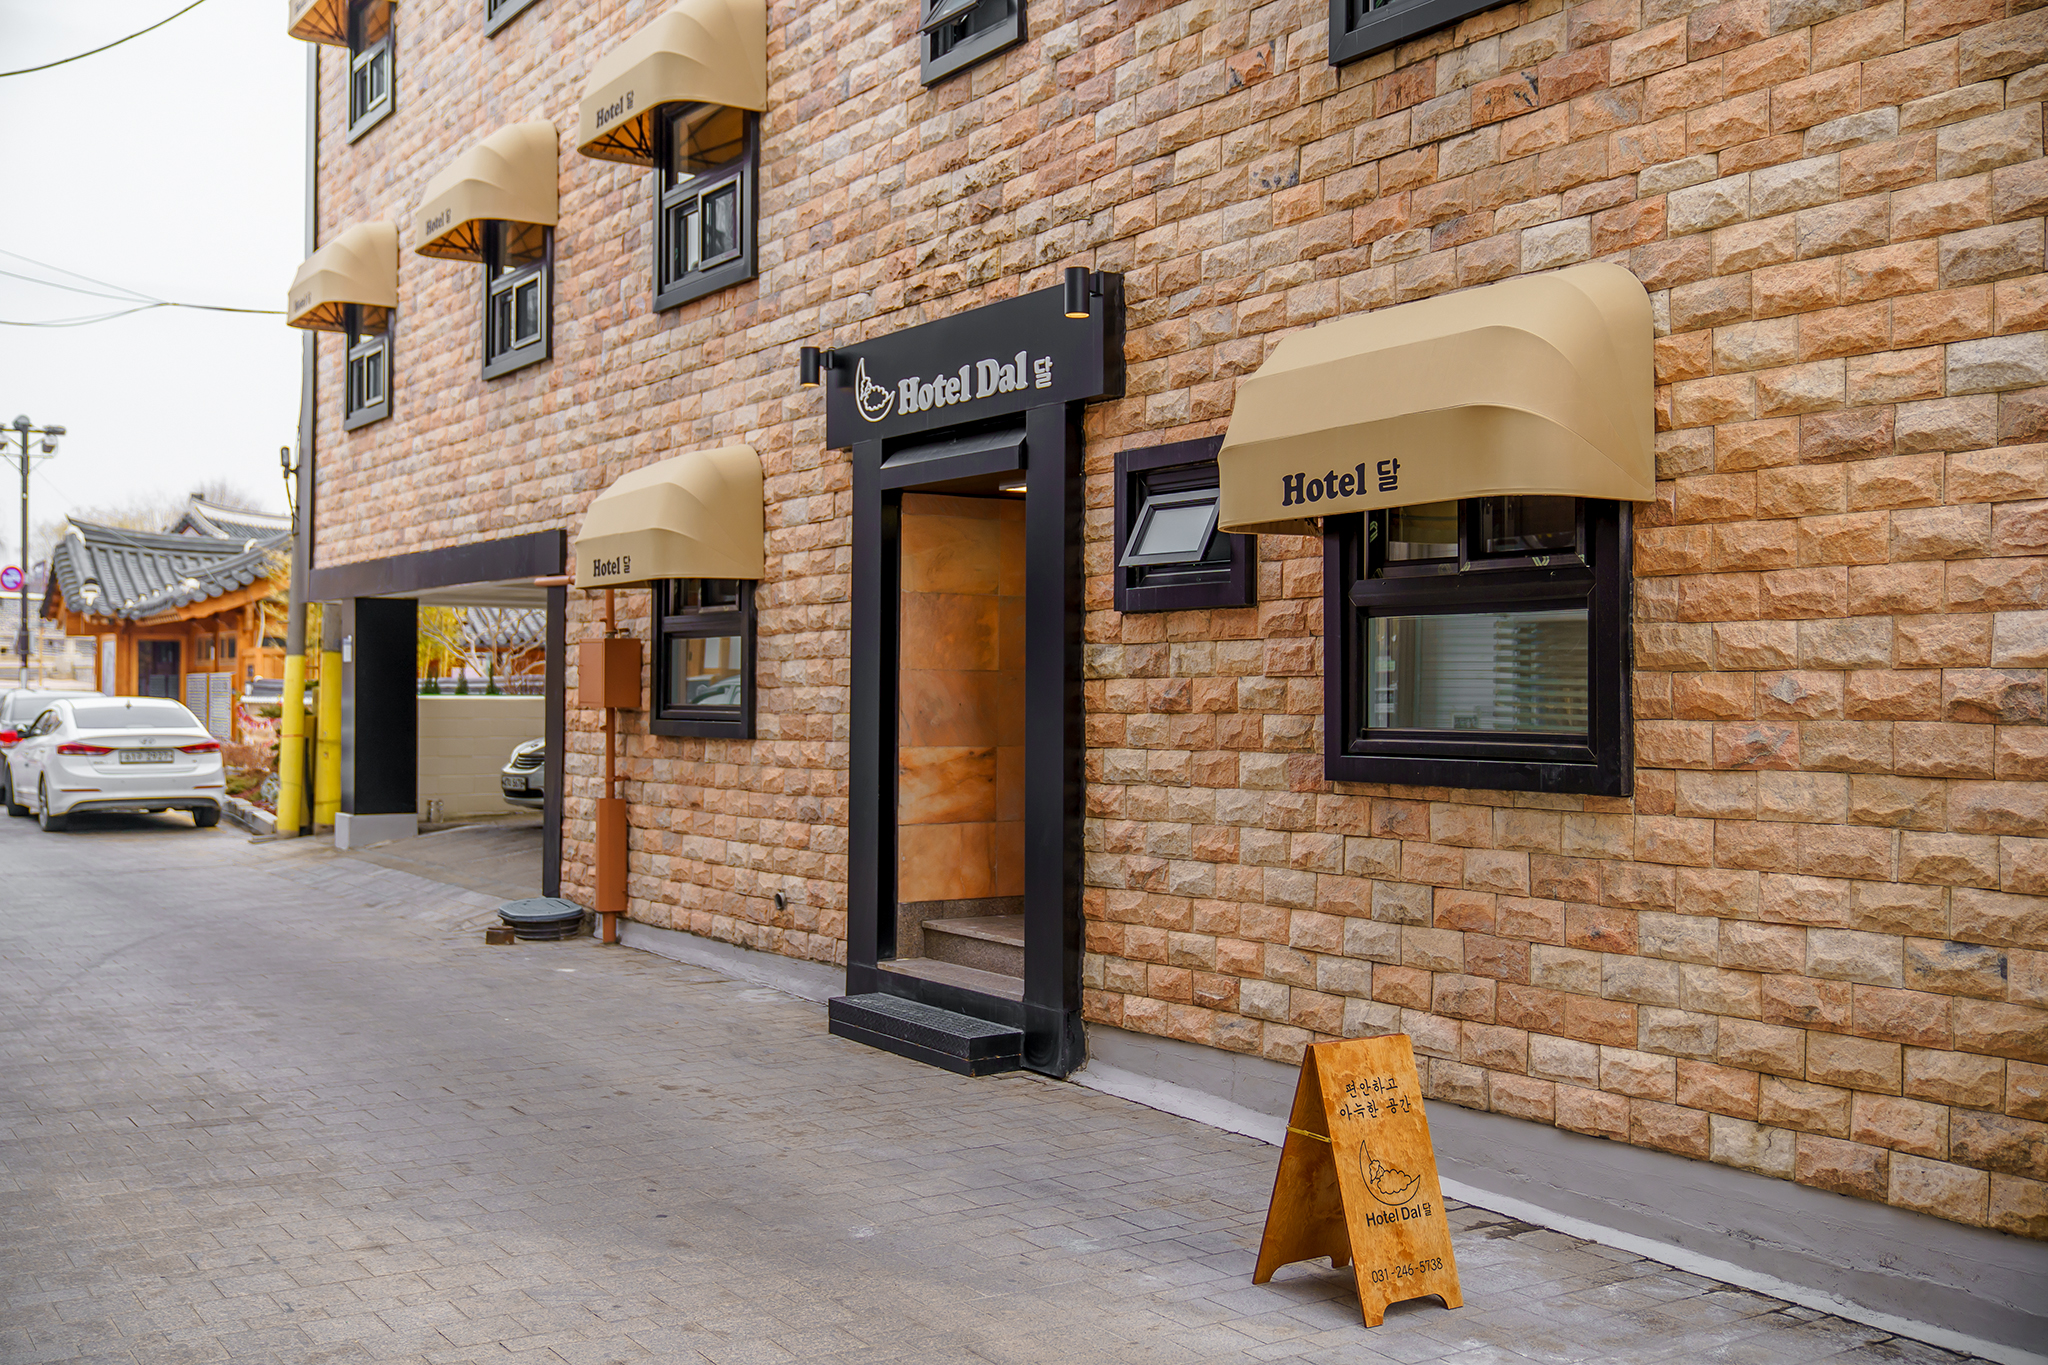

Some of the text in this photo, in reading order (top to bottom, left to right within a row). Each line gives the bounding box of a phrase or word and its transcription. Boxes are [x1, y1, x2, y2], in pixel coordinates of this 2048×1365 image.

[596, 95, 624, 129] Hotel
[897, 350, 1054, 415] Hotel Dal 달
[1282, 458, 1400, 506] Hotel 달
[593, 555, 631, 577] Hotel 달
[1346, 1077, 1398, 1098] 편안하고
[1340, 1095, 1411, 1121] 아늑한 공간
[1366, 1202, 1432, 1227] Hotel Dal 달
[1371, 1257, 1443, 1283] 031-246-5738
